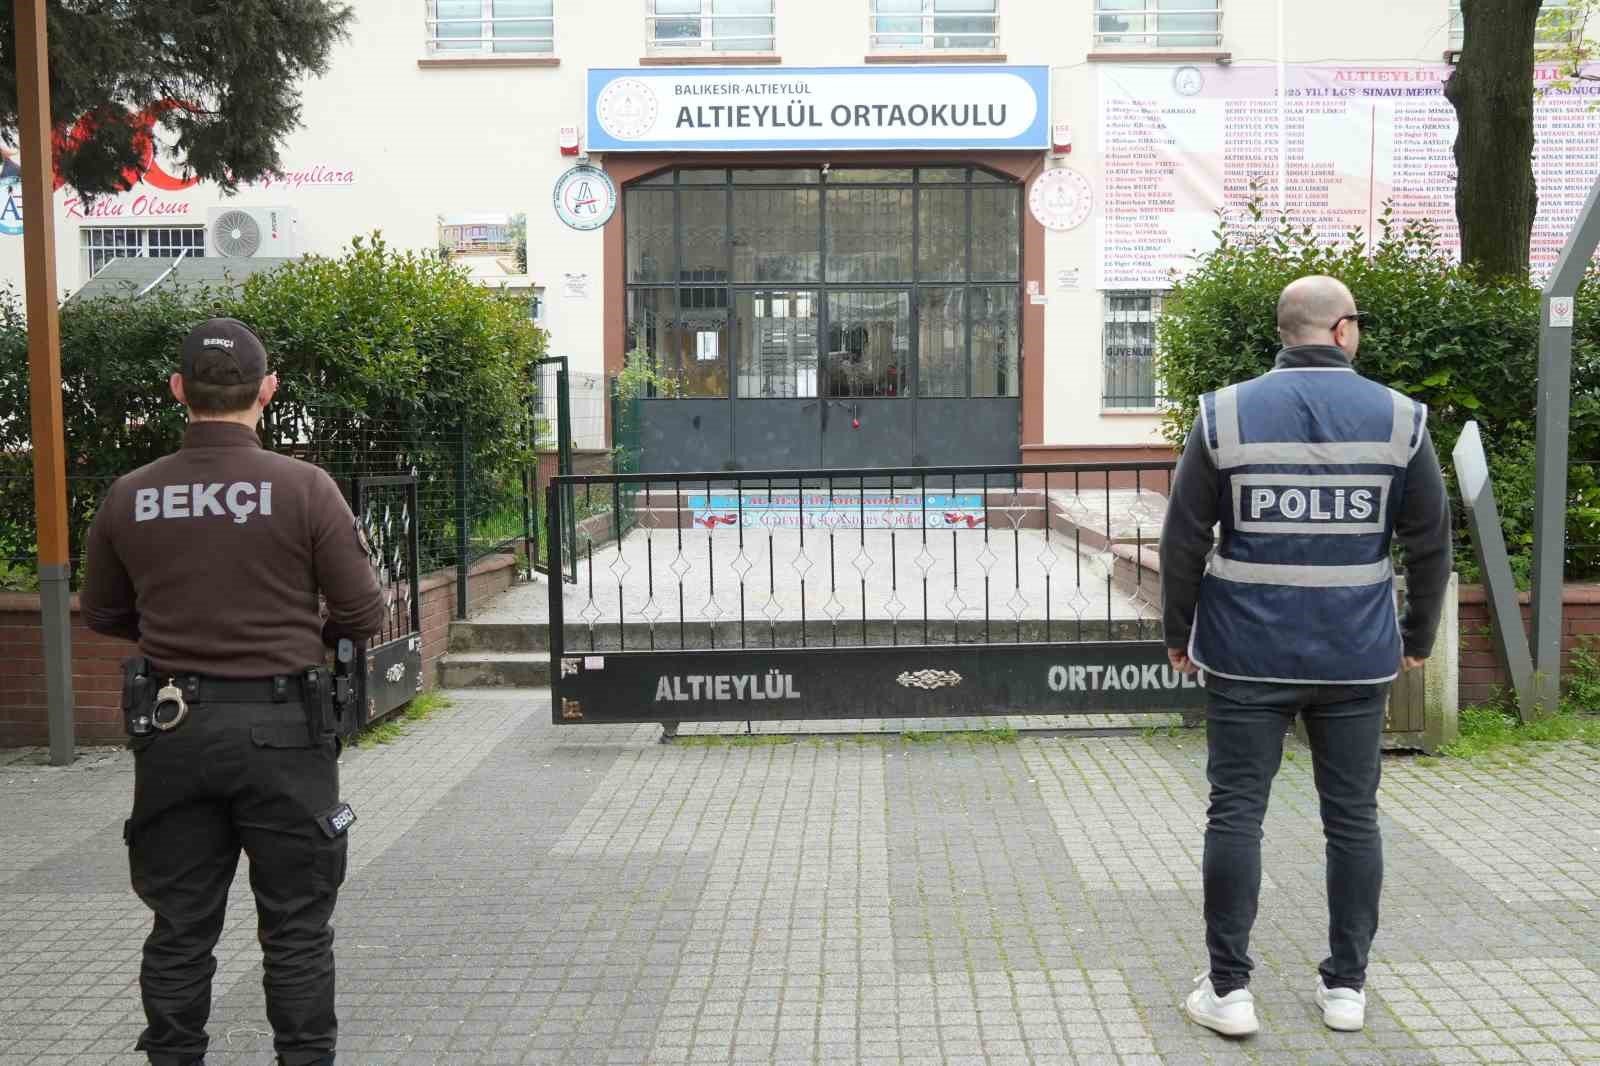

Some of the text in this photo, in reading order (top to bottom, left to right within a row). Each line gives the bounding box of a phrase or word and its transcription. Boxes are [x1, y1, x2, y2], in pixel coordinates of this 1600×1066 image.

[674, 82, 812, 95] BALIKESİR-ALTIEYLÜL
[676, 99, 1007, 129] ALTIEYLÜL ORTAOKULU
[131, 196, 190, 216] Olsun
[135, 481, 272, 524] BEKÇİ
[1251, 488, 1374, 520] POLİS
[656, 672, 801, 702] ALTIEYLÜL
